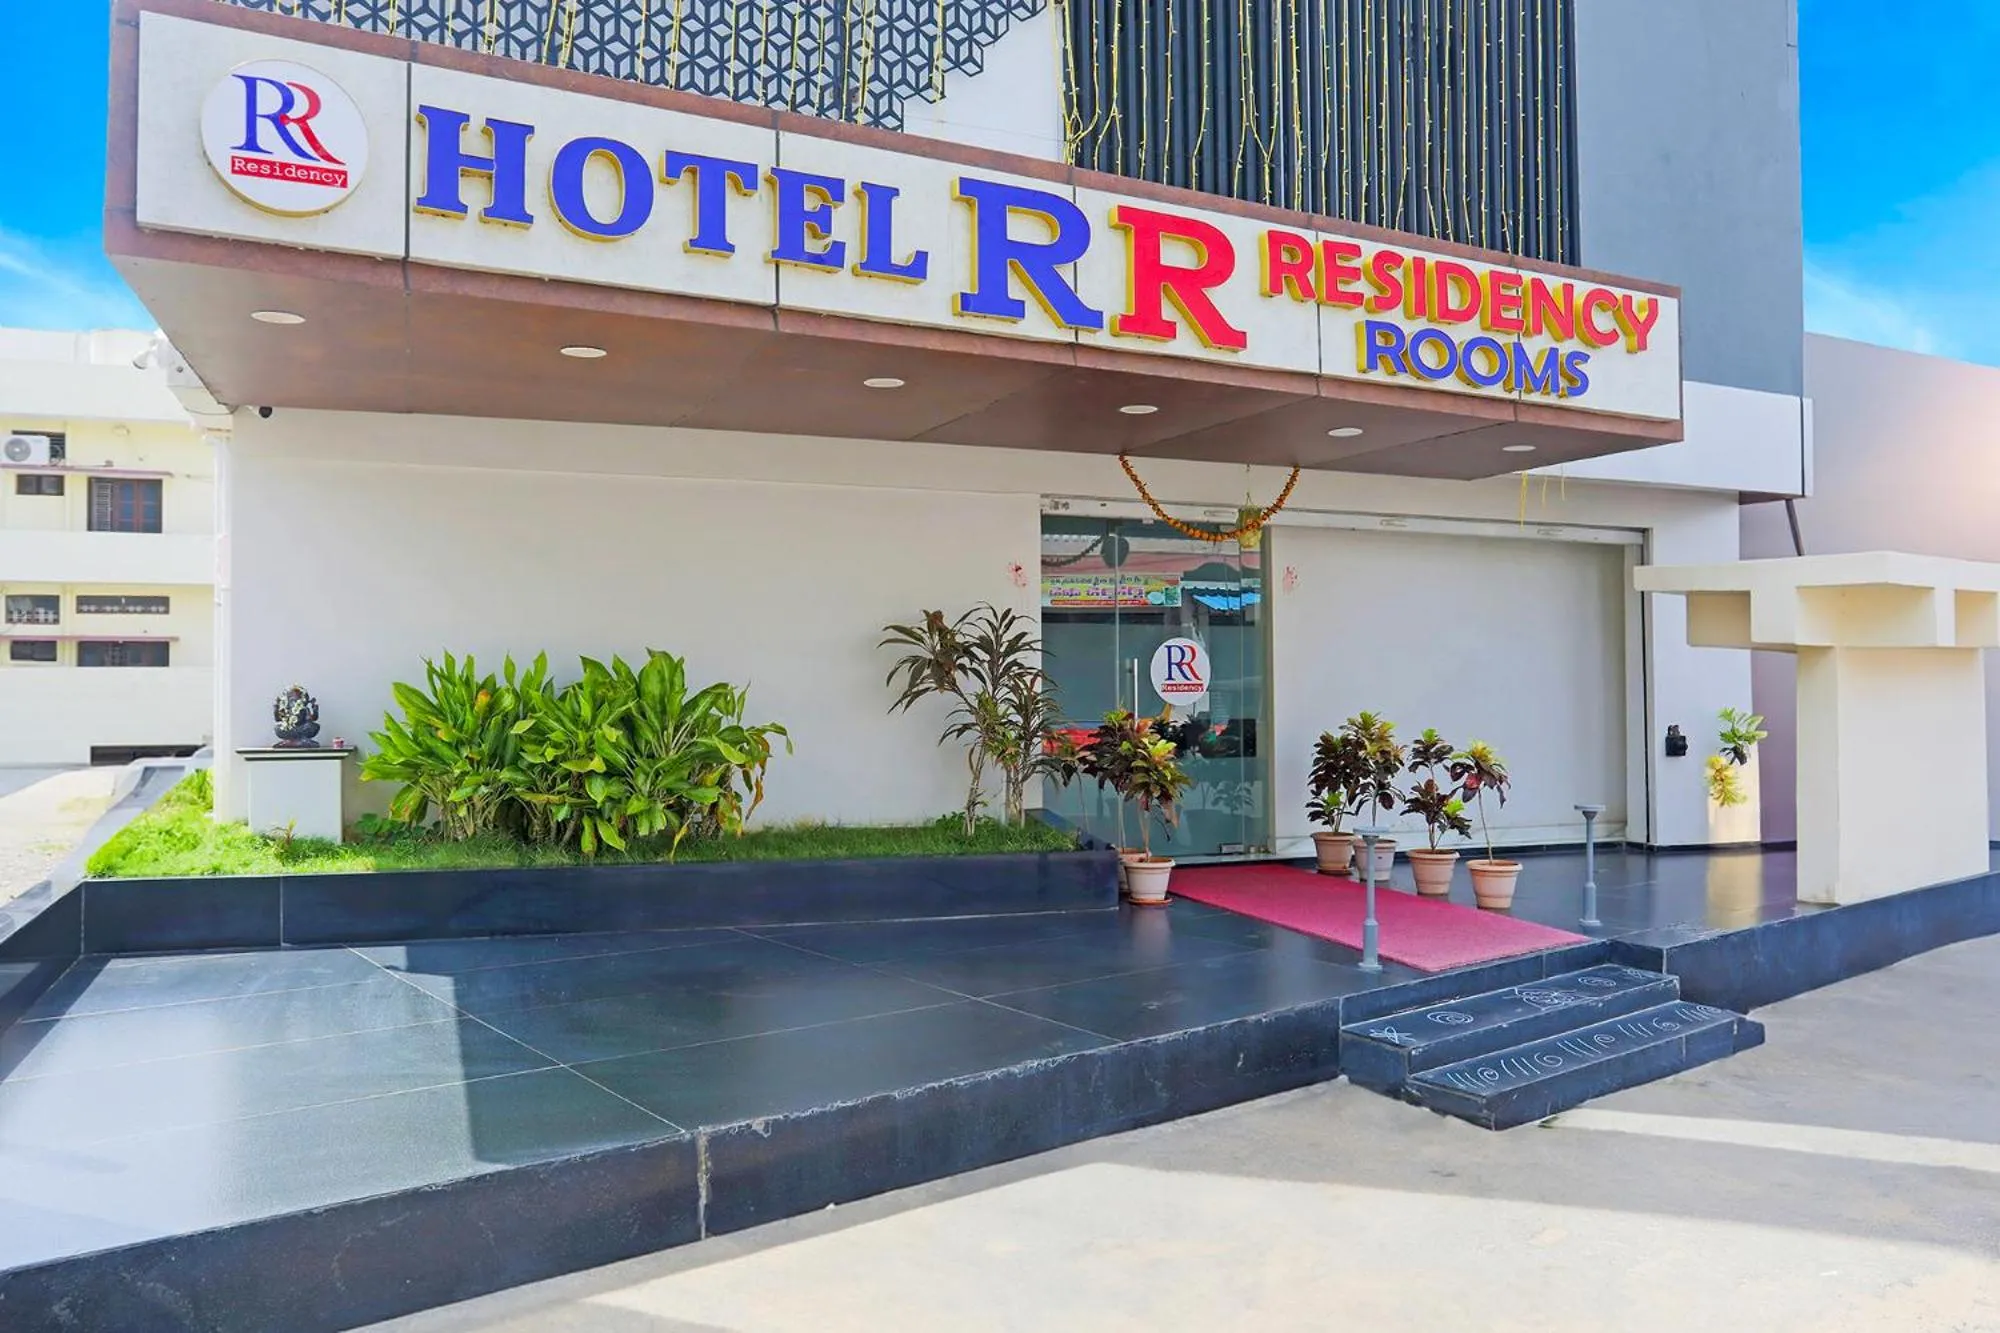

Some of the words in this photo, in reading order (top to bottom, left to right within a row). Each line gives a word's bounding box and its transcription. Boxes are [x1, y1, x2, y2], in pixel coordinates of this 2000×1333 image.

[230, 73, 346, 166] RR
[233, 157, 346, 188] Residency
[412, 104, 928, 284] HOTEL
[1259, 229, 1660, 354] RESIDENCY
[1356, 319, 1591, 399] ROOMS
[1161, 683, 1204, 692] Residency
[1164, 644, 1203, 681] RR
